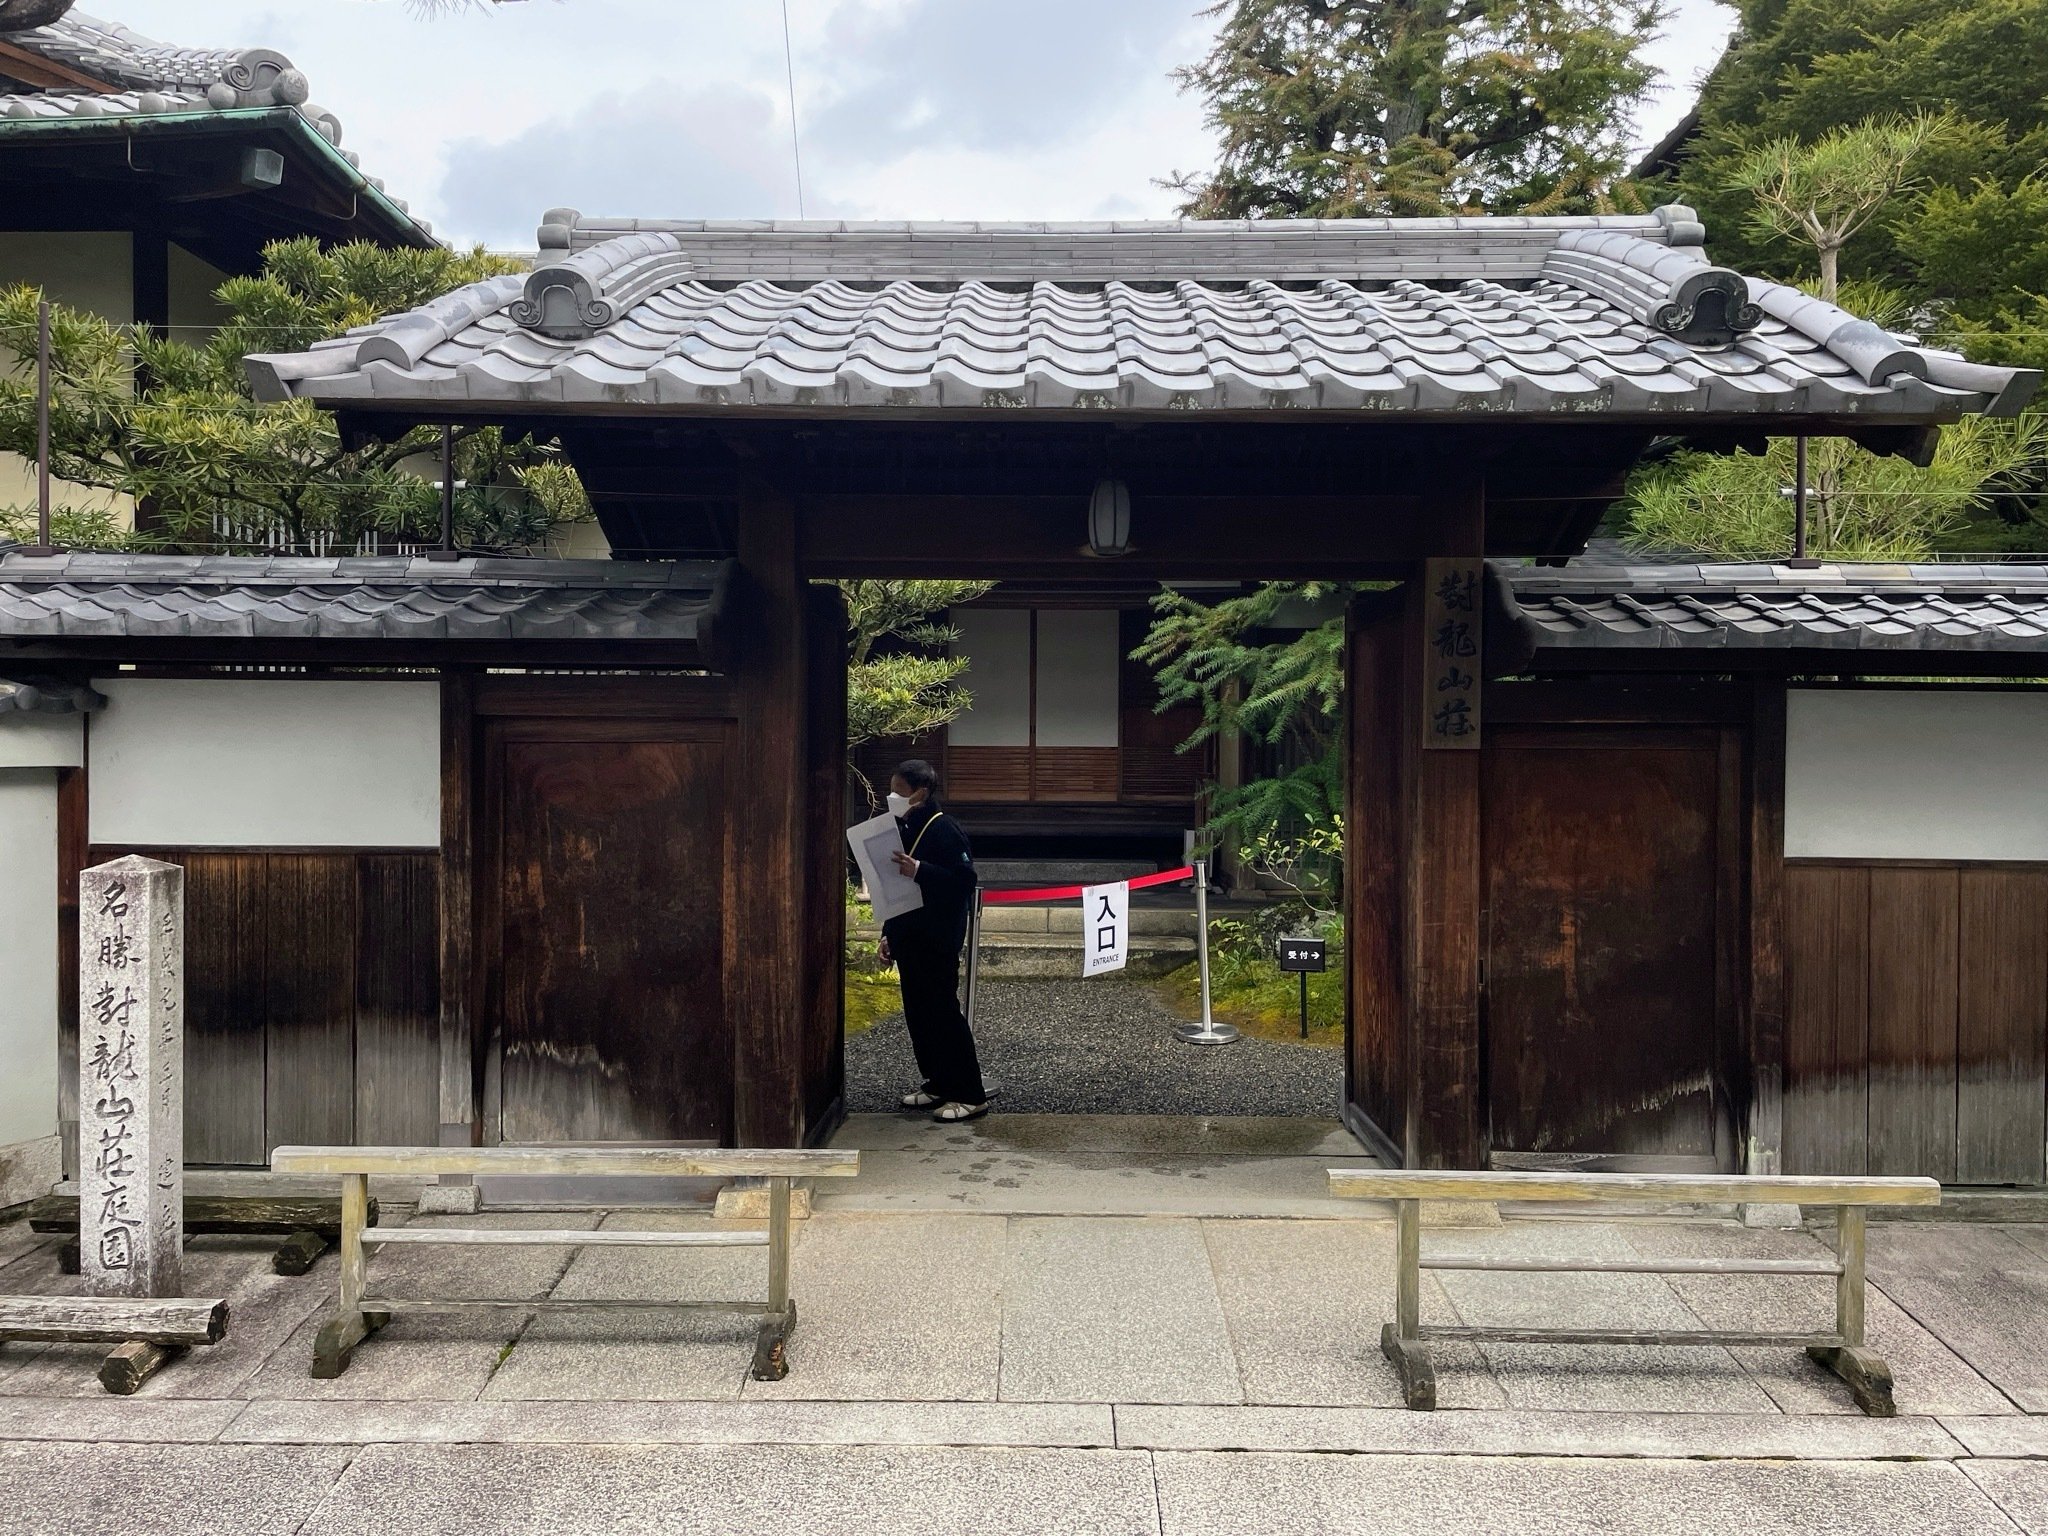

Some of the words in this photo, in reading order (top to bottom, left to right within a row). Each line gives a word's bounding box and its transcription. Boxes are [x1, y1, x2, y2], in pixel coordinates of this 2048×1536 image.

[1097, 895, 1116, 952] 入口
[1092, 954, 1119, 967] ENTRANCE
[1288, 950, 1308, 960] 受付
